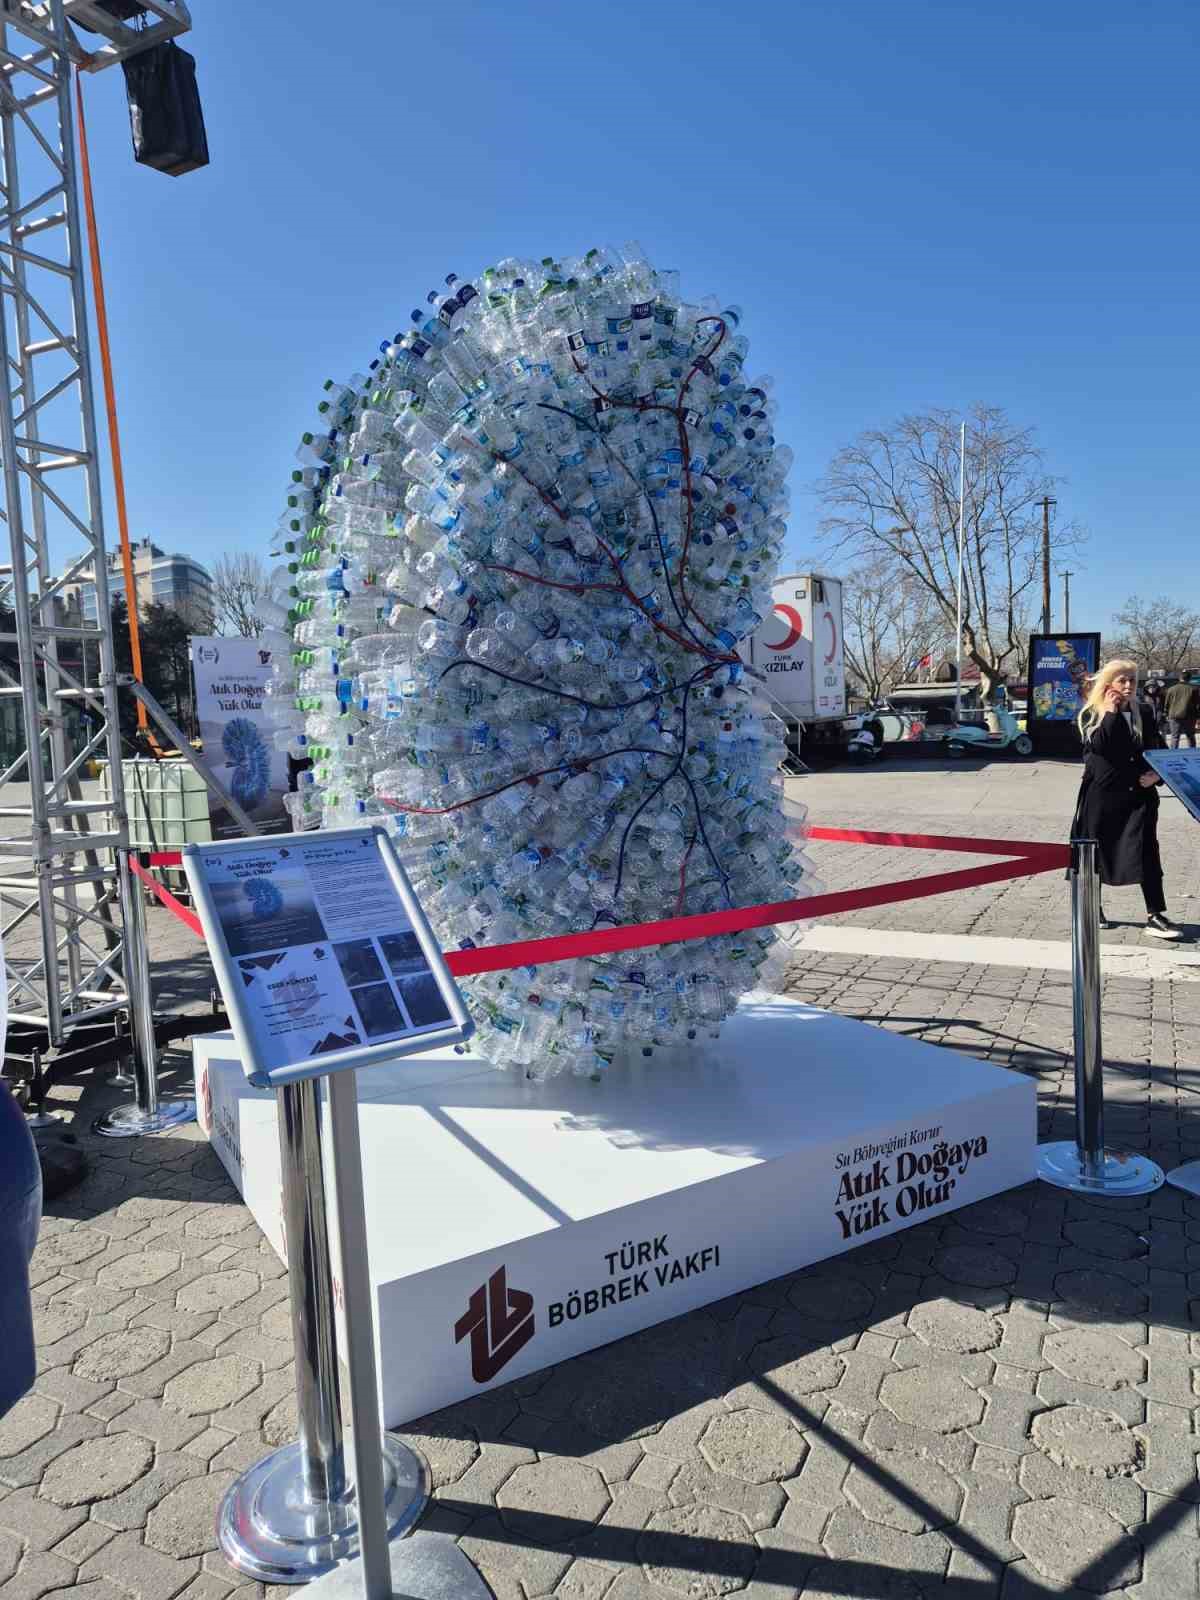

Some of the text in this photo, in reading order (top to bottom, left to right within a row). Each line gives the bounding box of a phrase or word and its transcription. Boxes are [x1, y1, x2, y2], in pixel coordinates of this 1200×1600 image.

[835, 1125, 944, 1170] Su Böbreğini Korur
[835, 1136, 989, 1205] Atık Doğaya
[835, 1178, 956, 1240] Yük Olur
[604, 1234, 670, 1276] TÜRK
[548, 1245, 720, 1329] BÖBREK VAKFI
